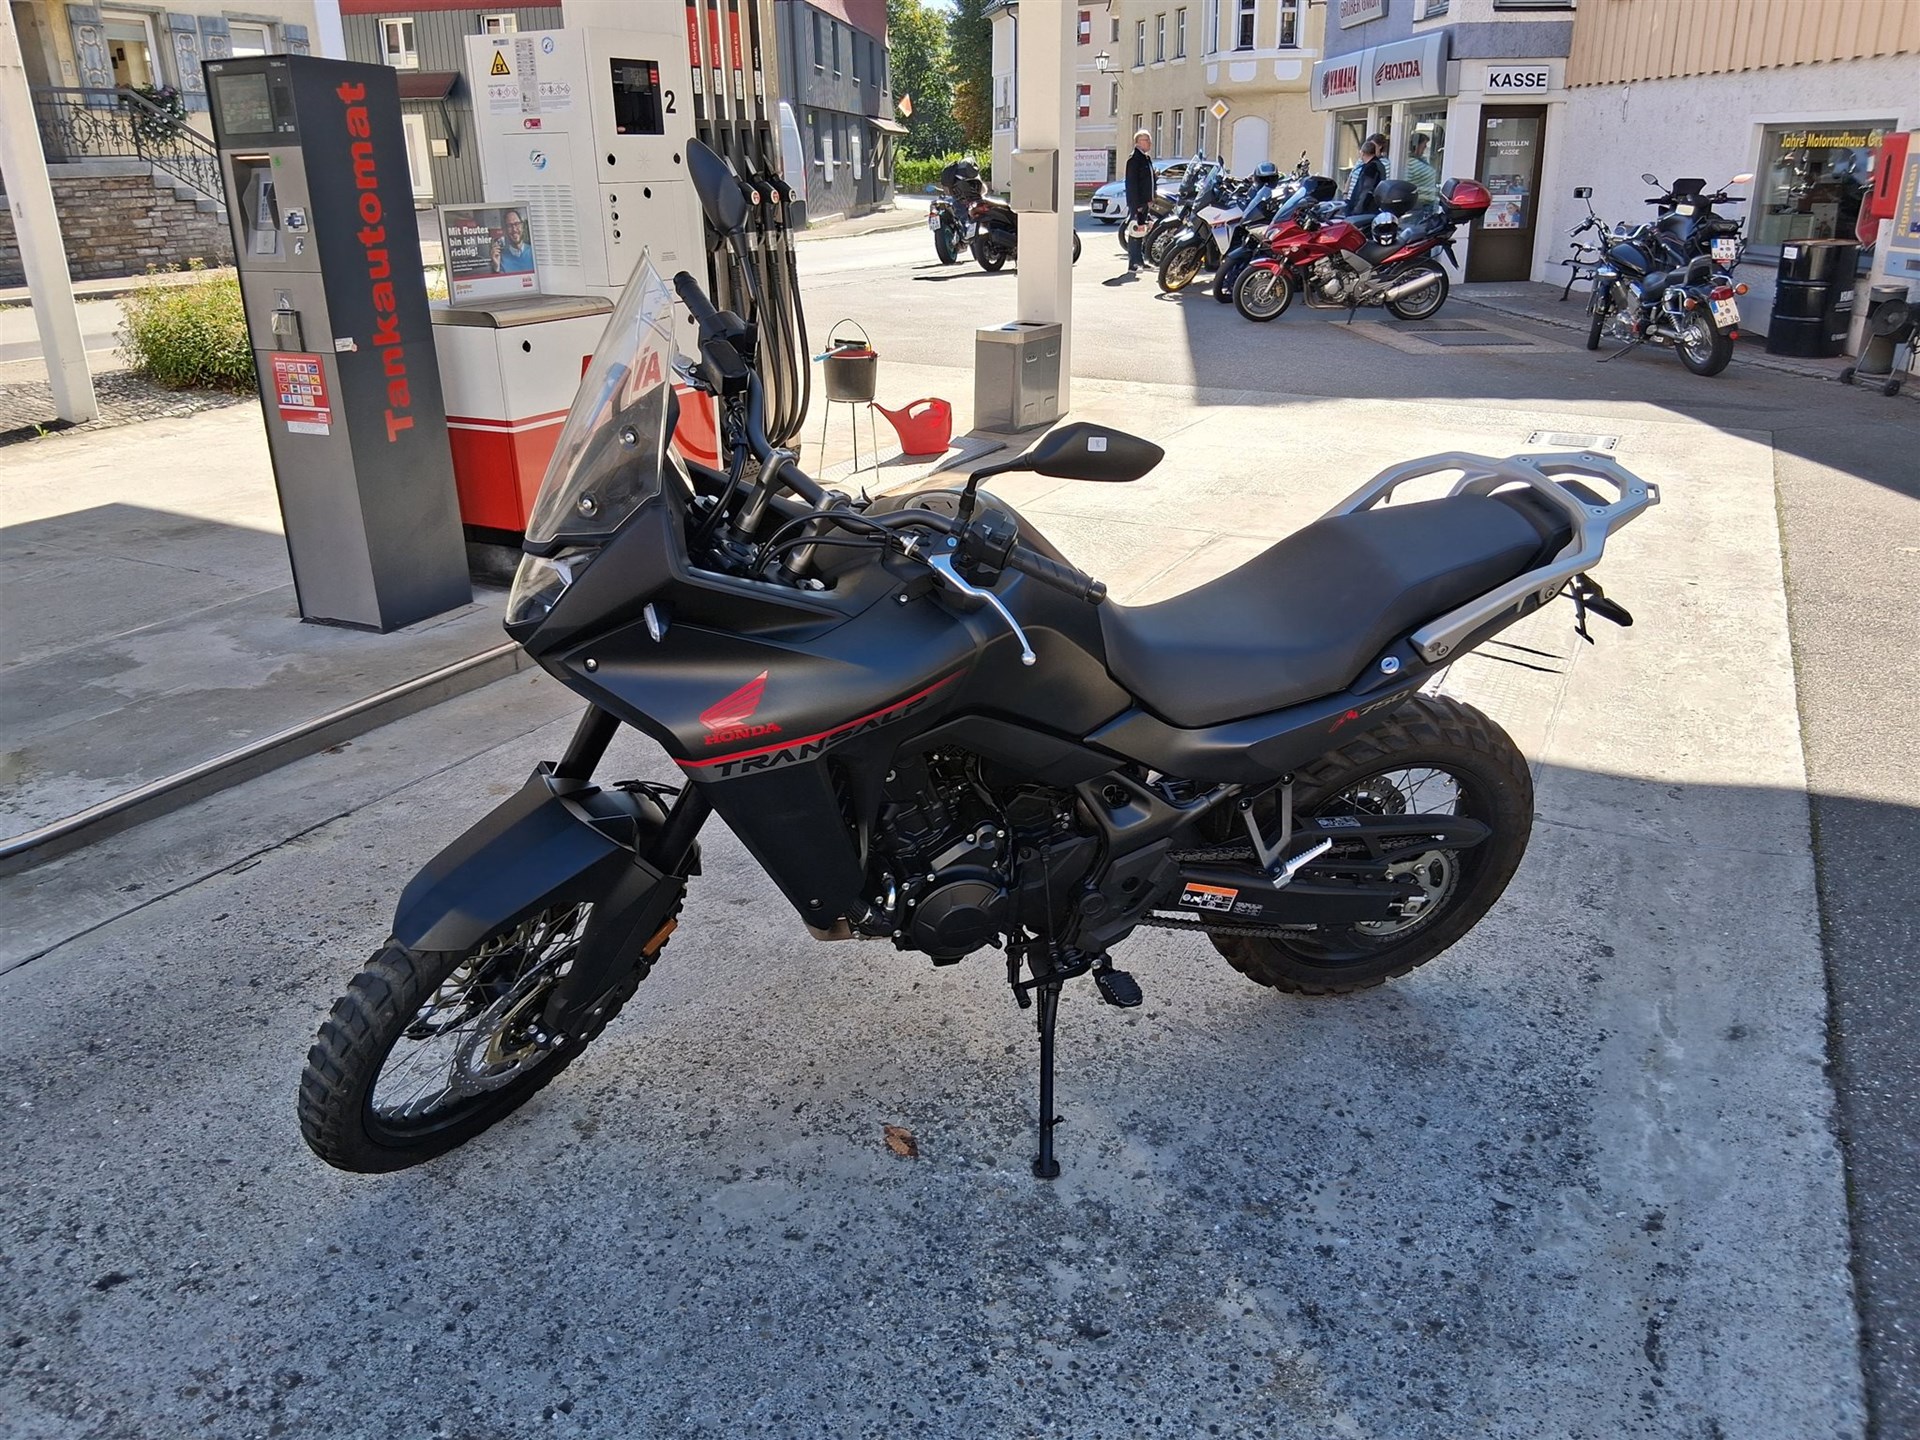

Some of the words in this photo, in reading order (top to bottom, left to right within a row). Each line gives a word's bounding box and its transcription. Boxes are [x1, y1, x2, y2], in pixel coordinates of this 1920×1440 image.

[496, 64, 504, 72] EX
[1330, 65, 1357, 92] YAMAHA
[1384, 60, 1420, 80] HONDA
[1489, 73, 1547, 87] KASSE
[664, 90, 677, 114] 2
[1781, 133, 1806, 148] Jahre
[1806, 131, 1866, 148] Motorradhaus
[1897, 163, 1918, 237] Zigaretten
[448, 227, 461, 236] Mit
[462, 227, 489, 236] Routex
[449, 238, 462, 246] bin
[463, 237, 476, 246] ich
[477, 236, 492, 244] hier
[336, 82, 414, 442] Tankautomat
[451, 247, 478, 257] richtig!
[1360, 689, 1410, 716] 750
[704, 722, 782, 746] HONDA
[714, 696, 928, 778] TRANSALP
